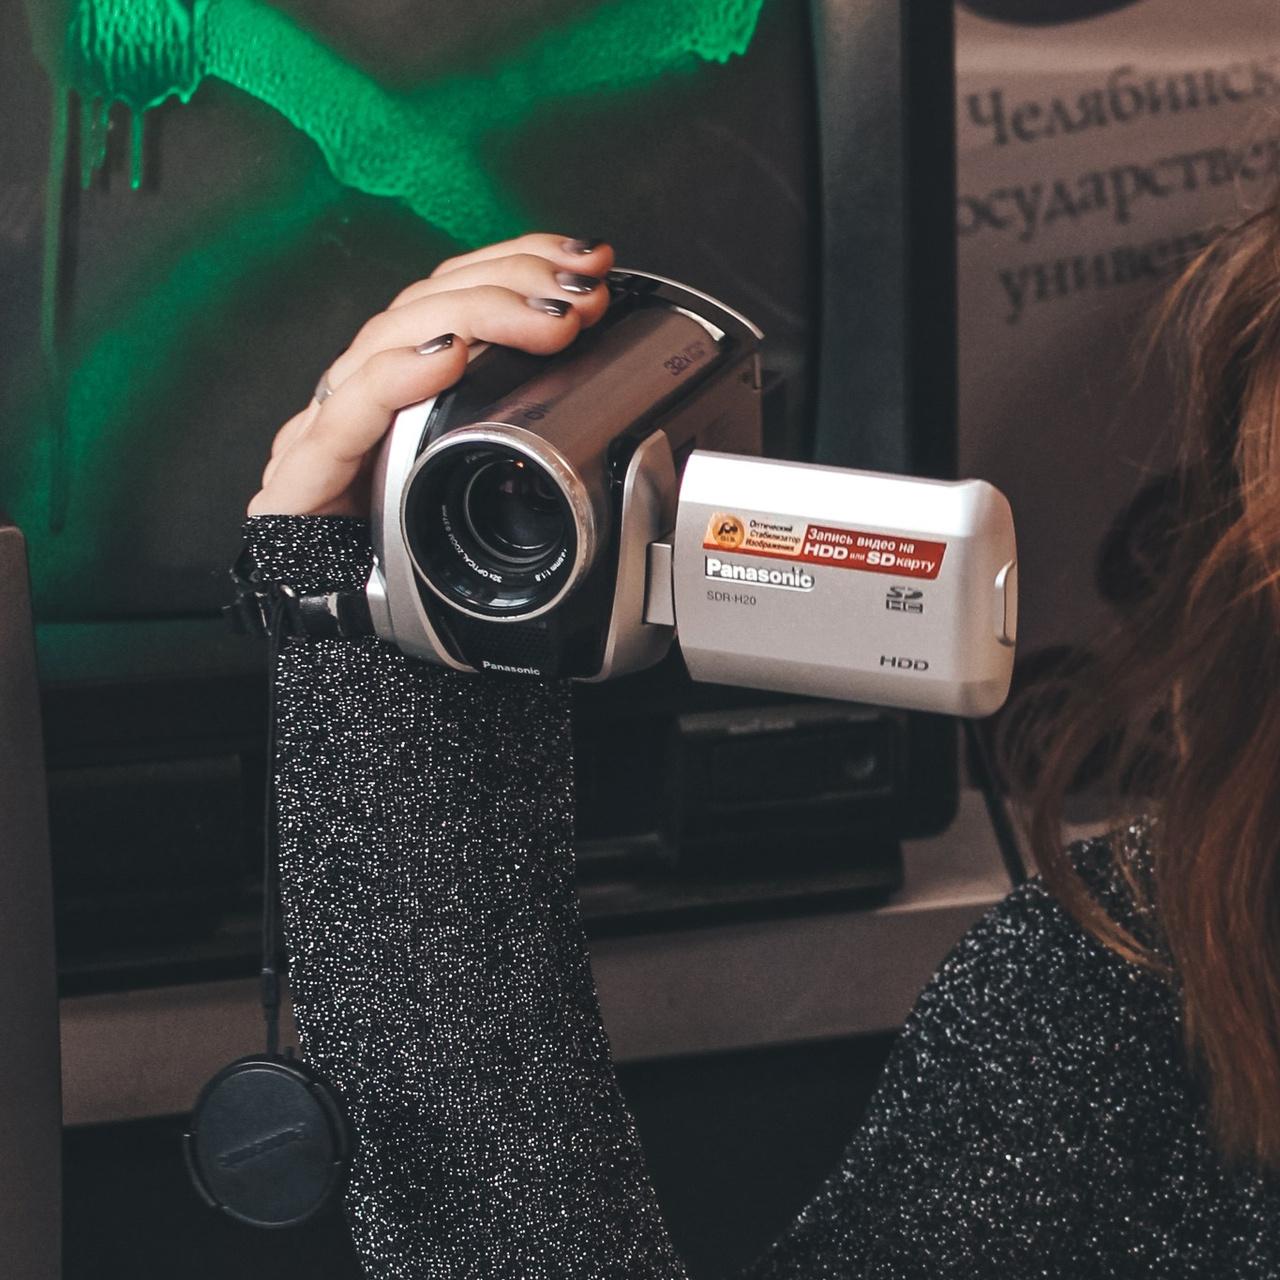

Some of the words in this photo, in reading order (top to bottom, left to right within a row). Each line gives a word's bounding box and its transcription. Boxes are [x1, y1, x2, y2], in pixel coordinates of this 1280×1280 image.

[448, 533, 464, 555] ZOOM
[807, 528, 853, 546] Запись
[856, 538, 896, 552] видео
[898, 542, 914, 554] на
[463, 553, 488, 577] OPTICAL
[804, 542, 848, 561] HDD
[866, 551, 895, 568] SD
[895, 556, 936, 574] карту
[705, 558, 814, 589] Panasonic
[706, 589, 757, 607] SDR-H20
[482, 660, 541, 676] Panasonic
[879, 654, 930, 672] HDD
